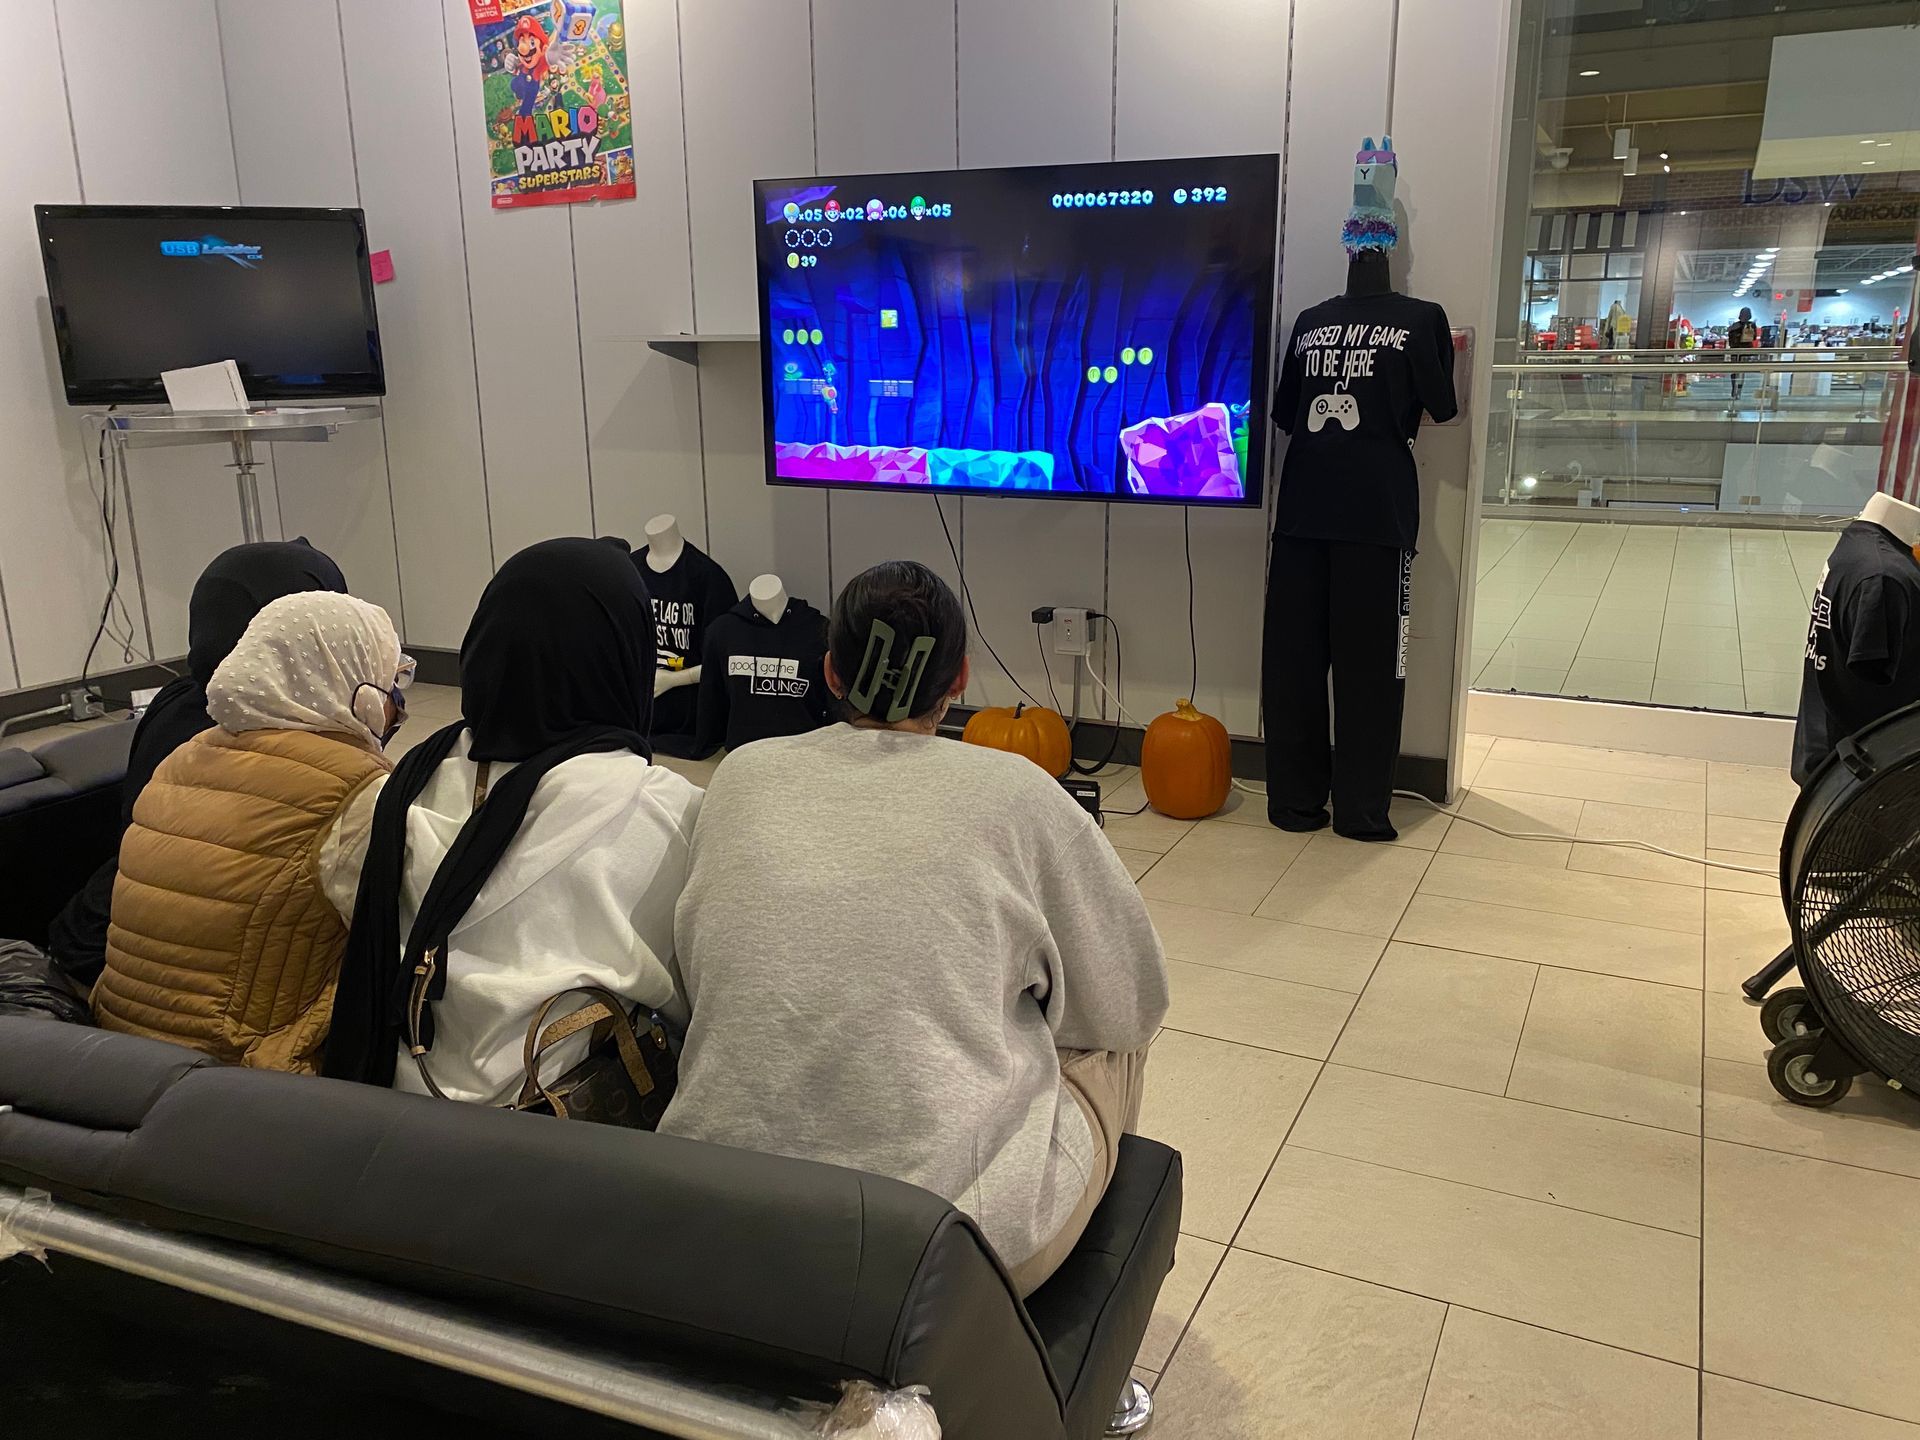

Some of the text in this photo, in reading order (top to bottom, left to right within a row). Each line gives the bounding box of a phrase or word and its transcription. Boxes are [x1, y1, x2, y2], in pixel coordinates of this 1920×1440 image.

[475, 10, 498, 19] SWITCH
[512, 105, 599, 145] MARIO
[514, 135, 600, 175] PARTY
[518, 165, 601, 190] SUPERSTARS
[1052, 187, 1227, 208] 000067320 392
[164, 243, 198, 255] USB
[800, 255, 818, 268] 39
[1298, 325, 1342, 356] PAUSED
[1342, 323, 1370, 347] MY
[1368, 325, 1410, 352] GAME
[1305, 348, 1377, 378] TO BE HERE
[660, 600, 680, 625] LAG
[682, 602, 695, 625] OR
[671, 627, 690, 650] YOU
[760, 662, 795, 675] game
[755, 678, 807, 694] LOUNGE
